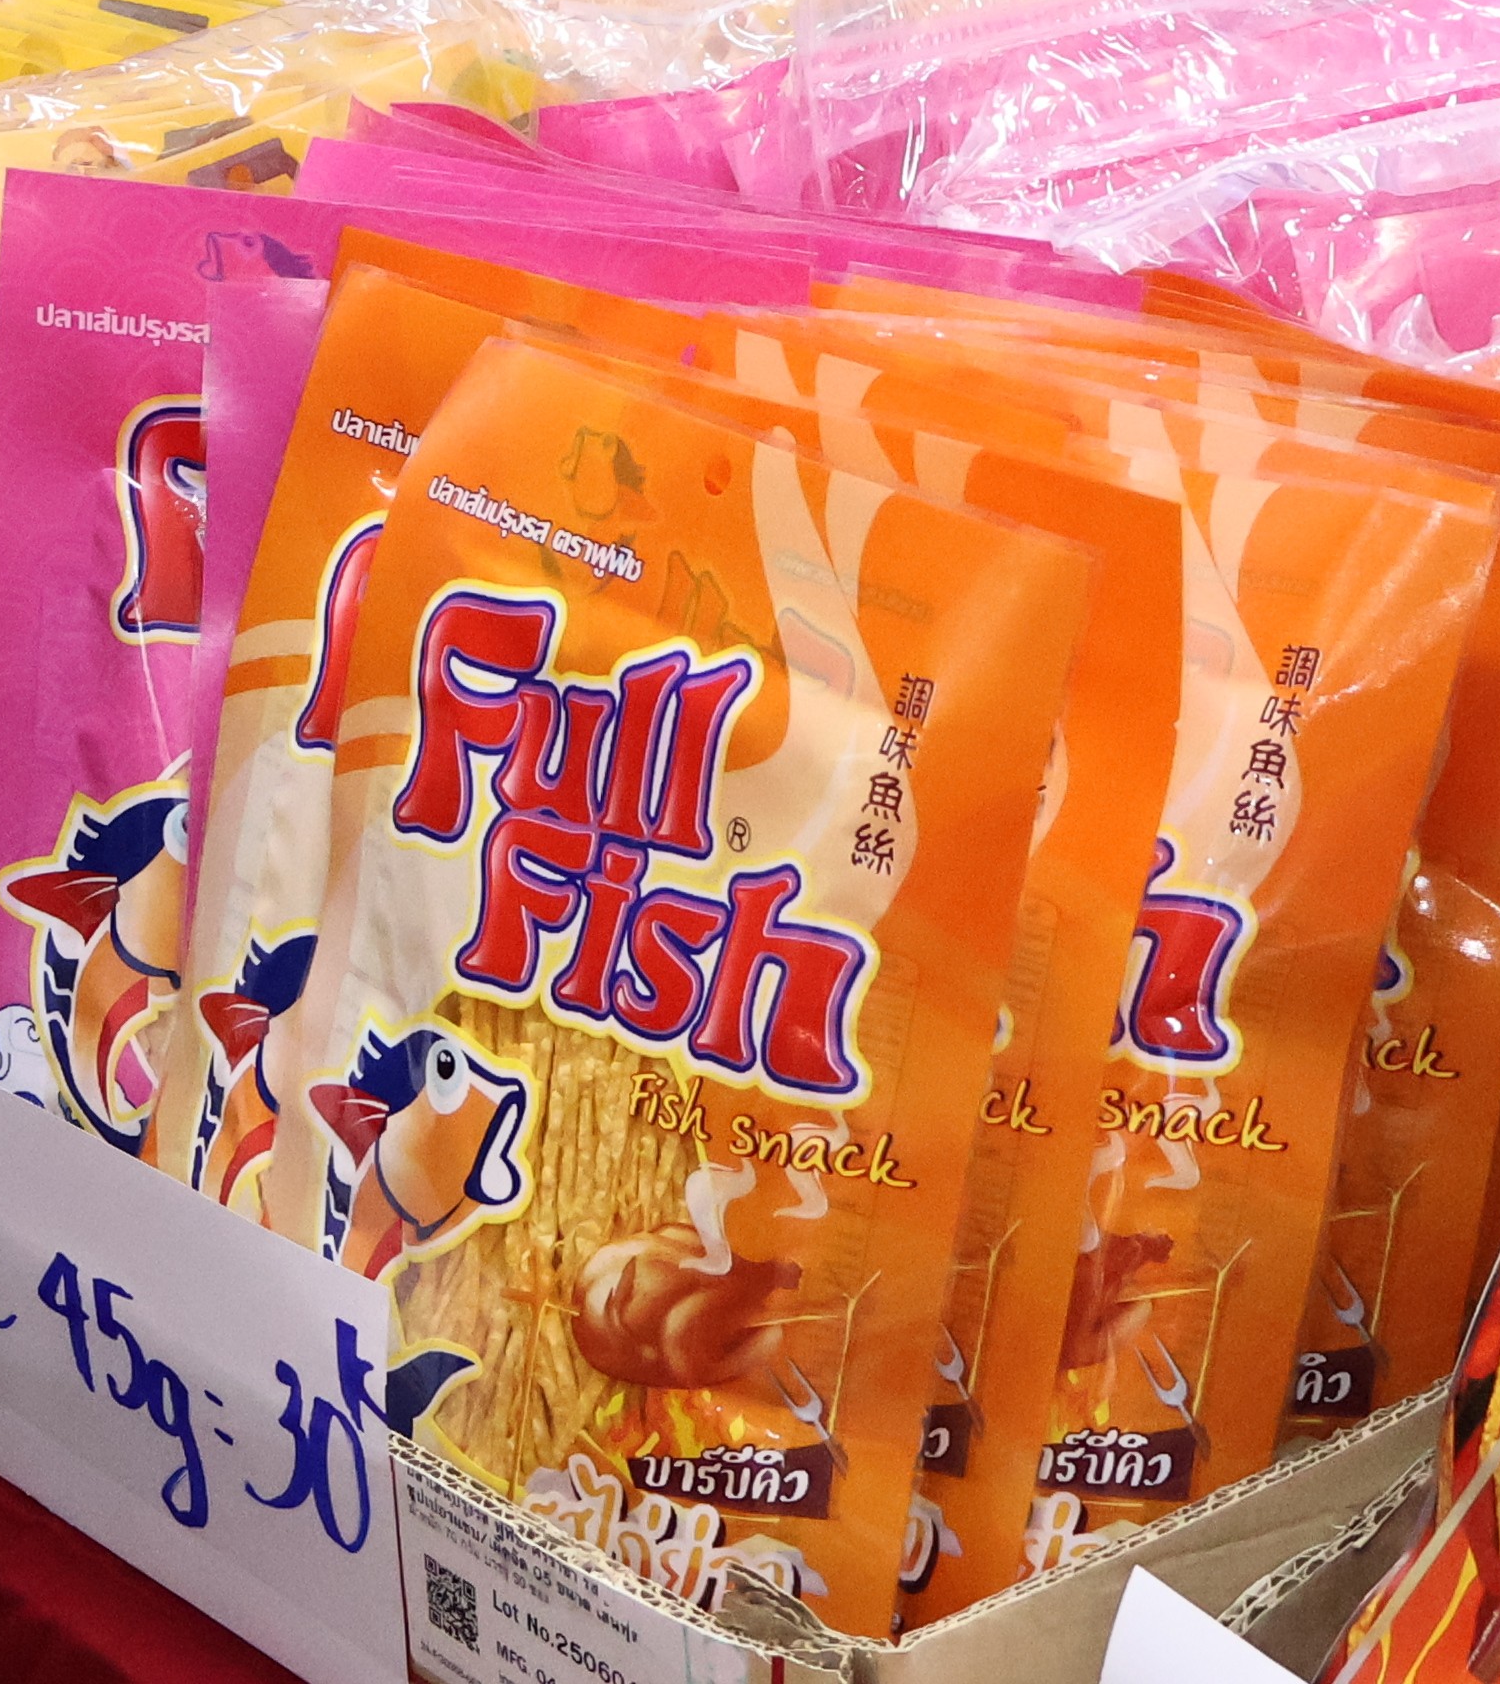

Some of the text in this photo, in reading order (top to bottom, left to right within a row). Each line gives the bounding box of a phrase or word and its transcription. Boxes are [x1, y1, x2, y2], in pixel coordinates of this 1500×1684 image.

[34, 300, 212, 348] ปลาเส้นปรุงรส
[426, 473, 645, 582] ปลาเส้นปรุงรส ตราฟูฟิช
[394, 590, 758, 859] Full
[1230, 644, 1322, 844] 調味魚絲
[848, 672, 936, 879] 調味魚絲
[455, 808, 867, 1096] Fish
[627, 1072, 709, 1145] Fish
[641, 1438, 811, 1507] บาร์บีคิว
[1039, 1430, 1172, 1490] าร์บีคิว
[492, 1589, 520, 1624] Lot
